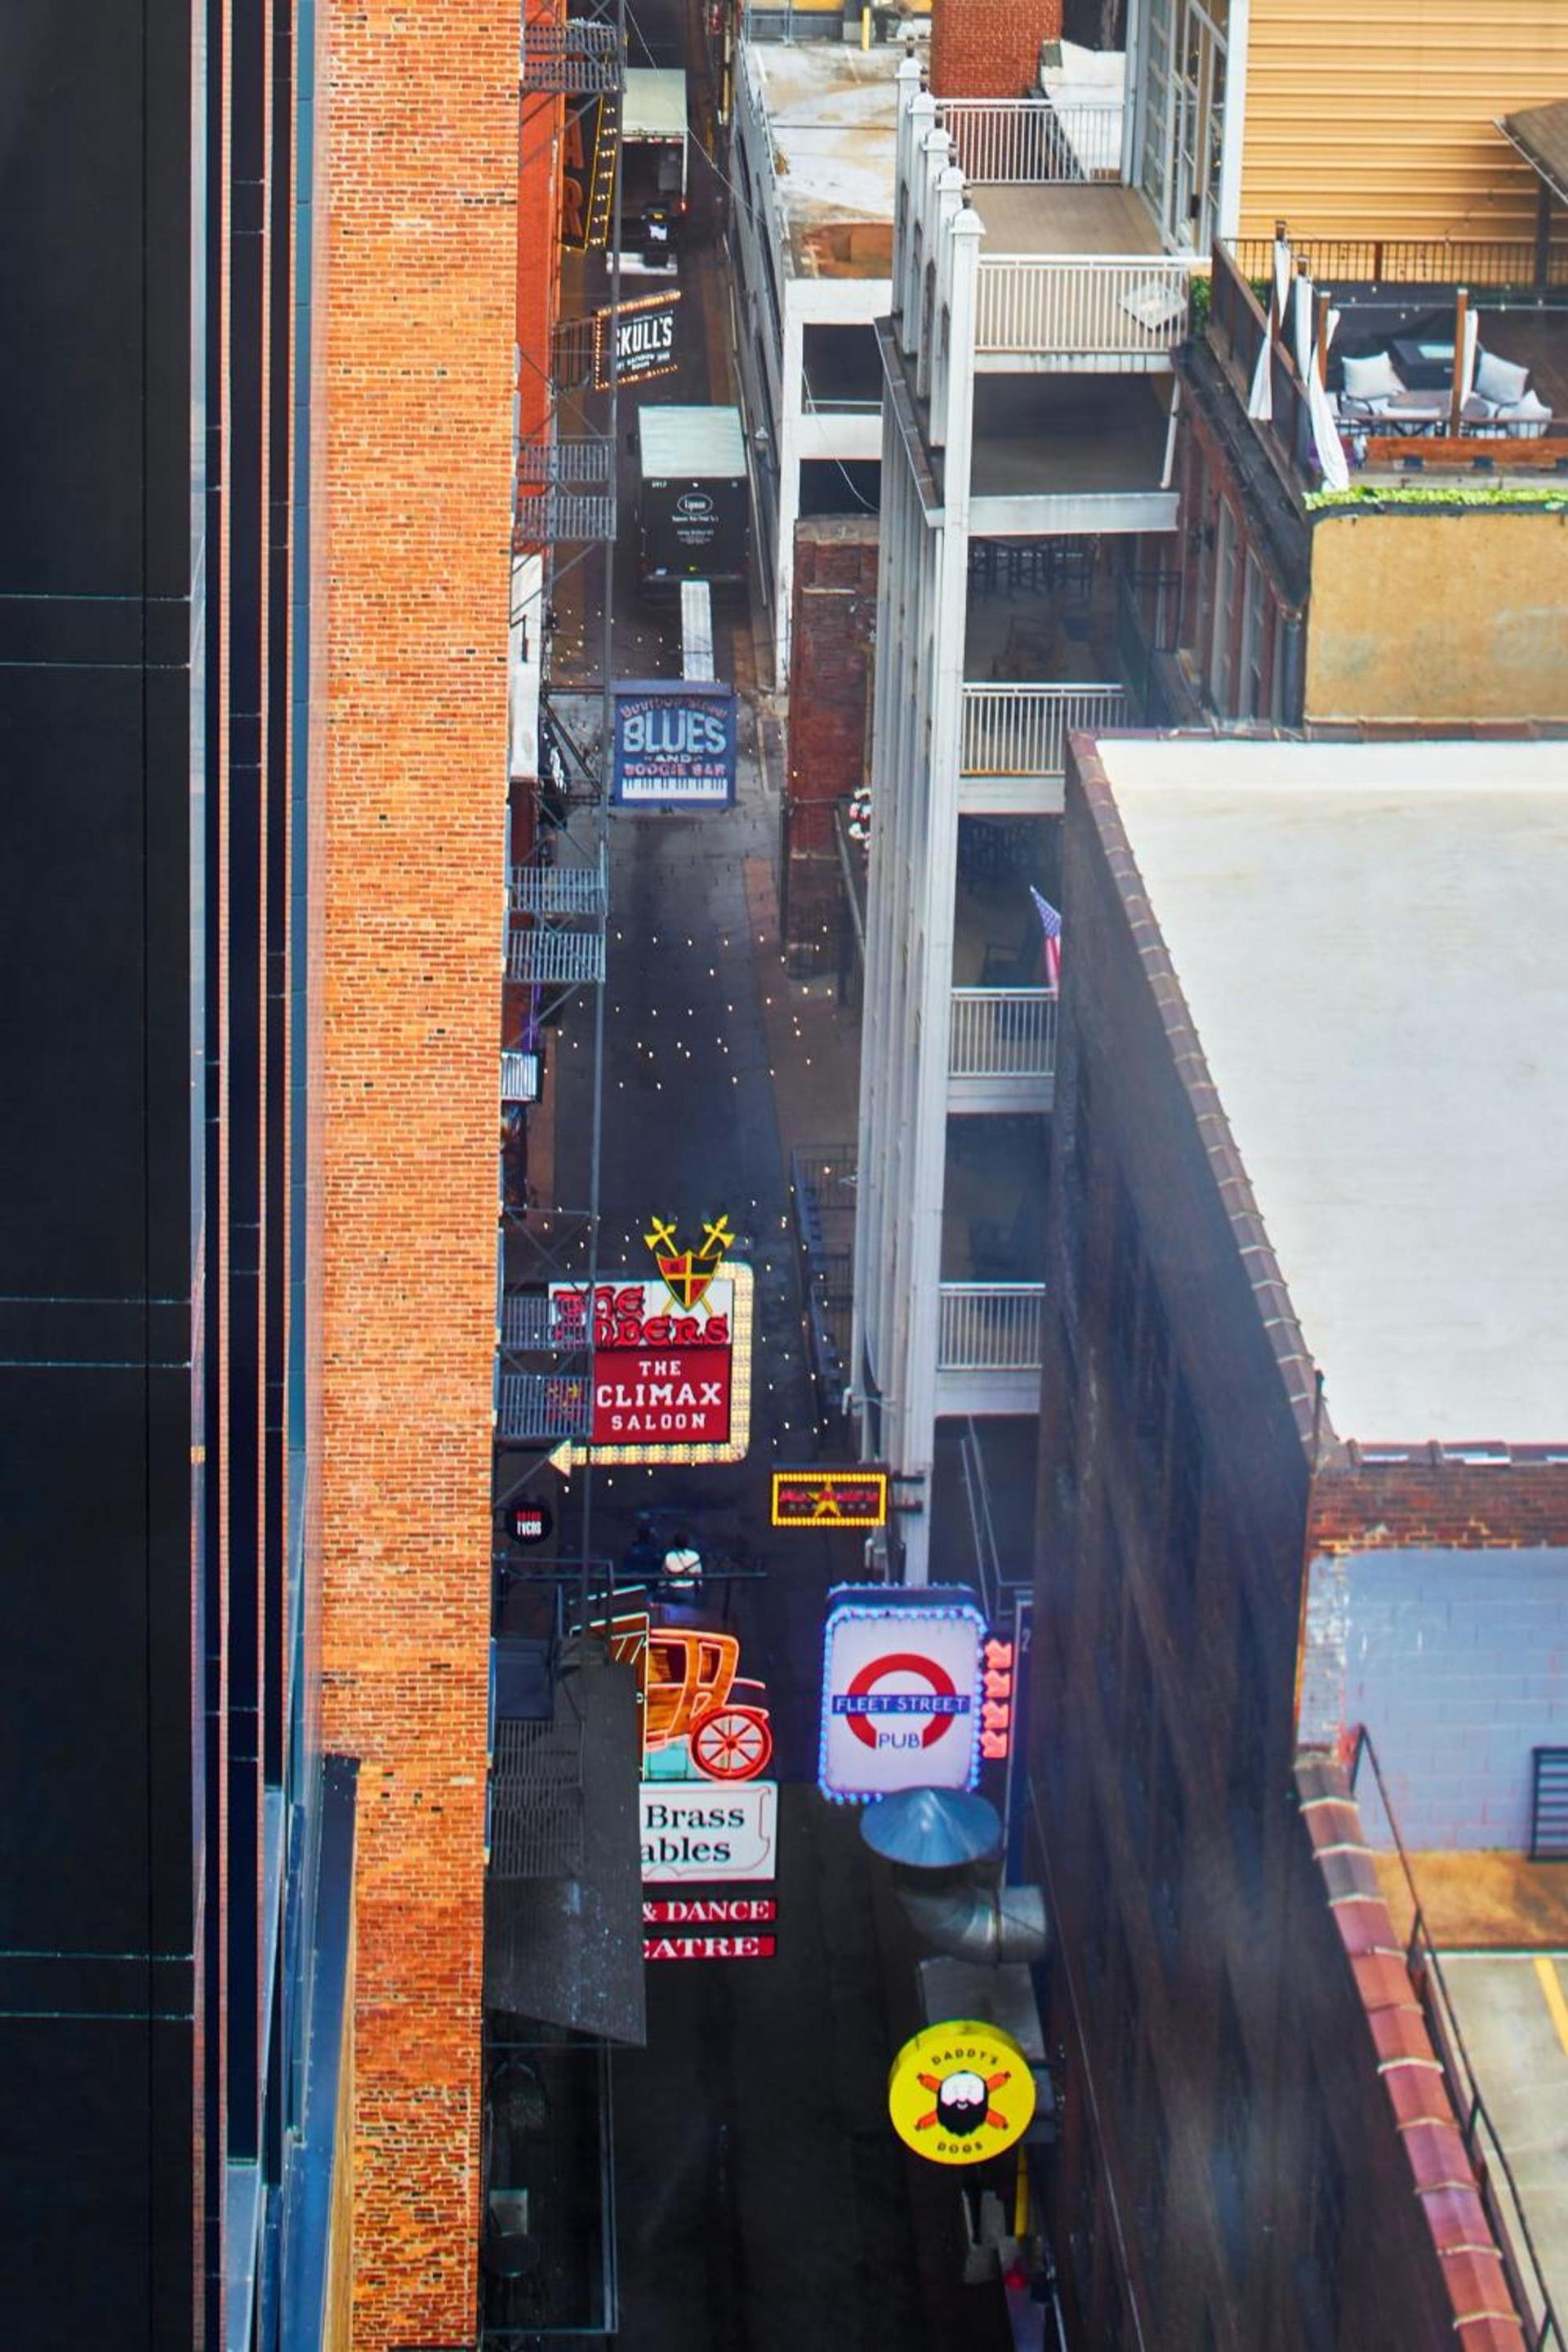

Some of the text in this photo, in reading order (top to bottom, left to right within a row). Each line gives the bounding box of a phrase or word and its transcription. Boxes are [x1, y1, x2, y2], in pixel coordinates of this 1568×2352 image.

[623, 706, 728, 755] BLUES
[654, 754, 693, 764] AND
[623, 763, 727, 777] BOOGIE BAR
[639, 1360, 682, 1376] THE
[596, 1382, 723, 1409] CLIMAX
[611, 1413, 706, 1431] SALOON
[835, 1696, 965, 1713] FLEET STREET
[878, 1732, 921, 1749] PUB
[645, 1804, 745, 1829] Brass
[667, 1900, 770, 1921] DANCE
[937, 2141, 983, 2154] DOGS
